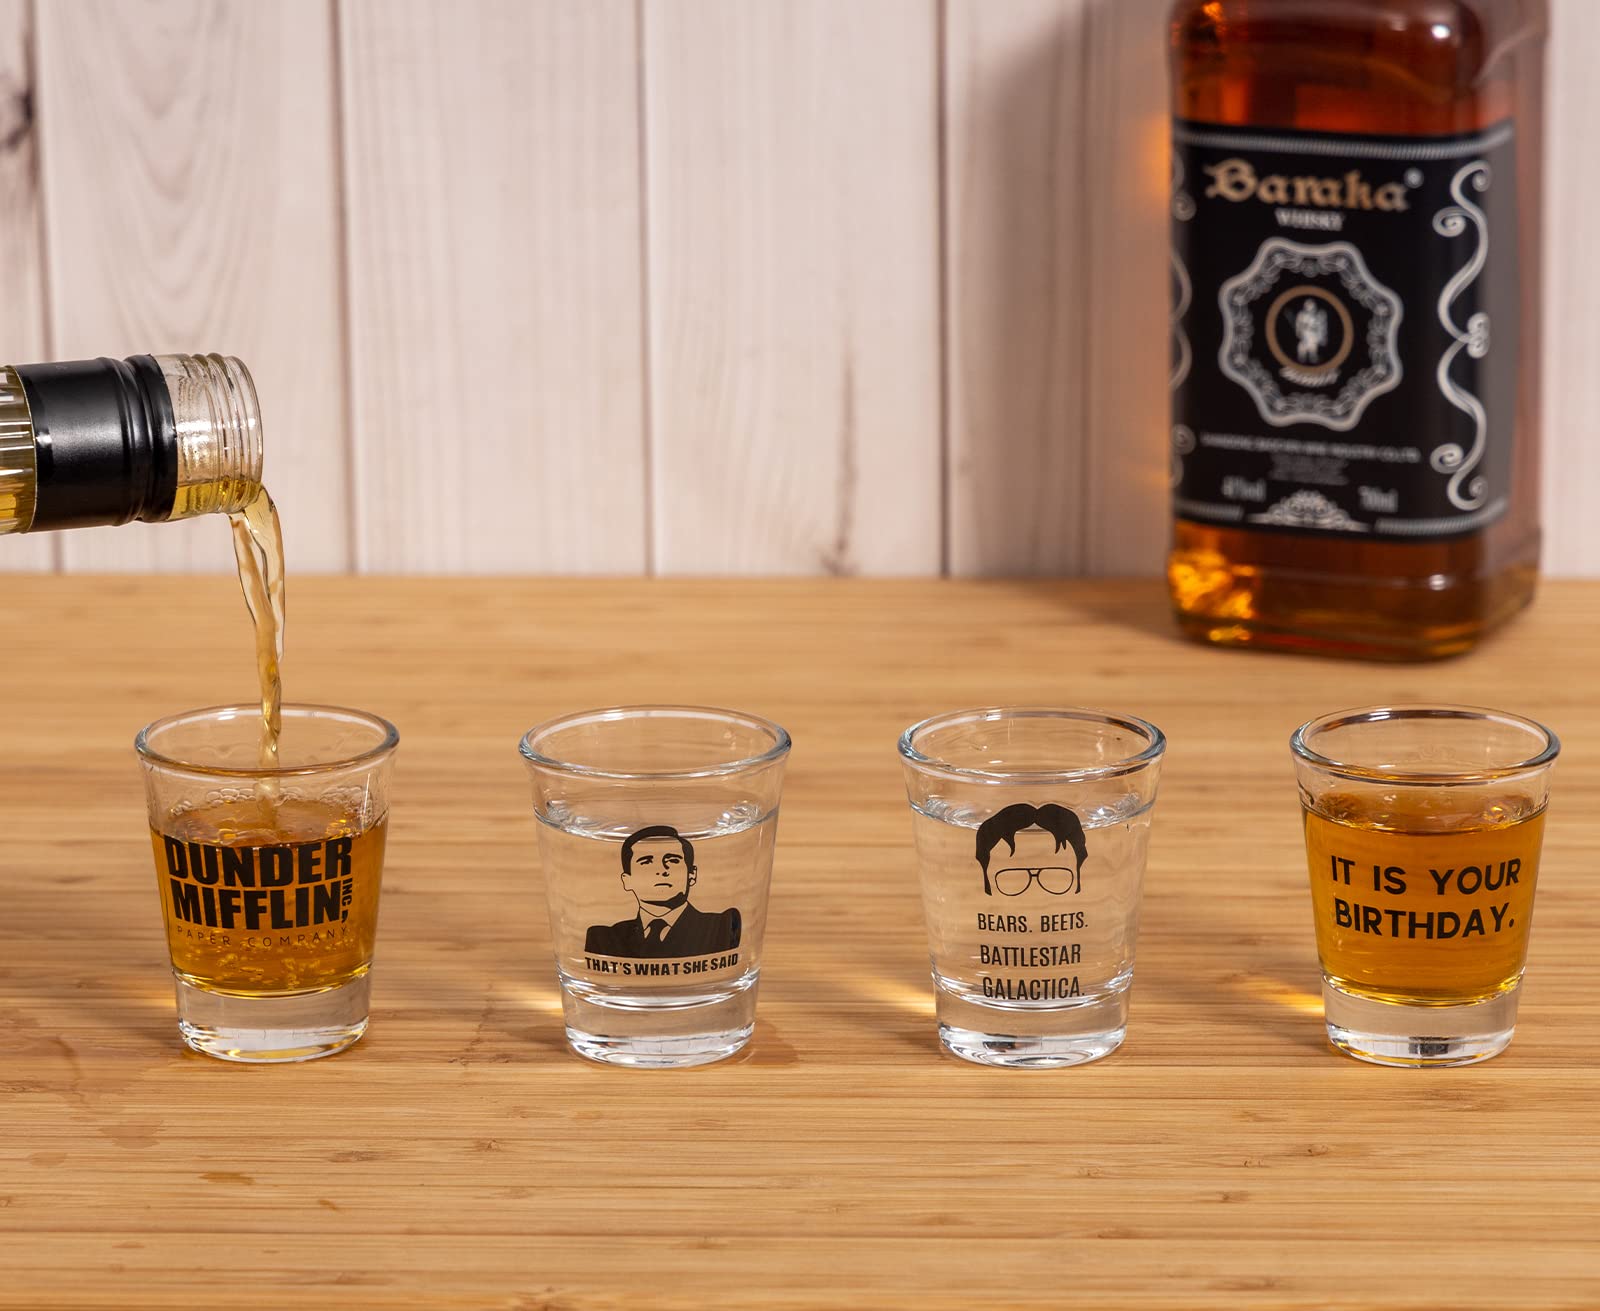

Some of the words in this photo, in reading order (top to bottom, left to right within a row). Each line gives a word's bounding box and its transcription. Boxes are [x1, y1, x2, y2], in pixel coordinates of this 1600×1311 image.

[164, 835, 352, 887] DUNDER
[1331, 855, 1356, 885] IT
[1373, 865, 1407, 895] IS
[1429, 858, 1521, 896] YOUR
[977, 913, 1033, 933] BEARS.
[1040, 911, 1089, 933] BEETS.
[1334, 897, 1515, 939] BIRTHDAY.
[177, 925, 231, 946] PAPER
[247, 926, 348, 948] COMPANY
[584, 956, 632, 975] THAT'S
[634, 963, 681, 976] WHAT
[683, 959, 709, 975] SHE
[710, 952, 739, 971] SAID
[980, 944, 1081, 967] BATTLESTAR
[982, 976, 1085, 1001] GALACTICA.
